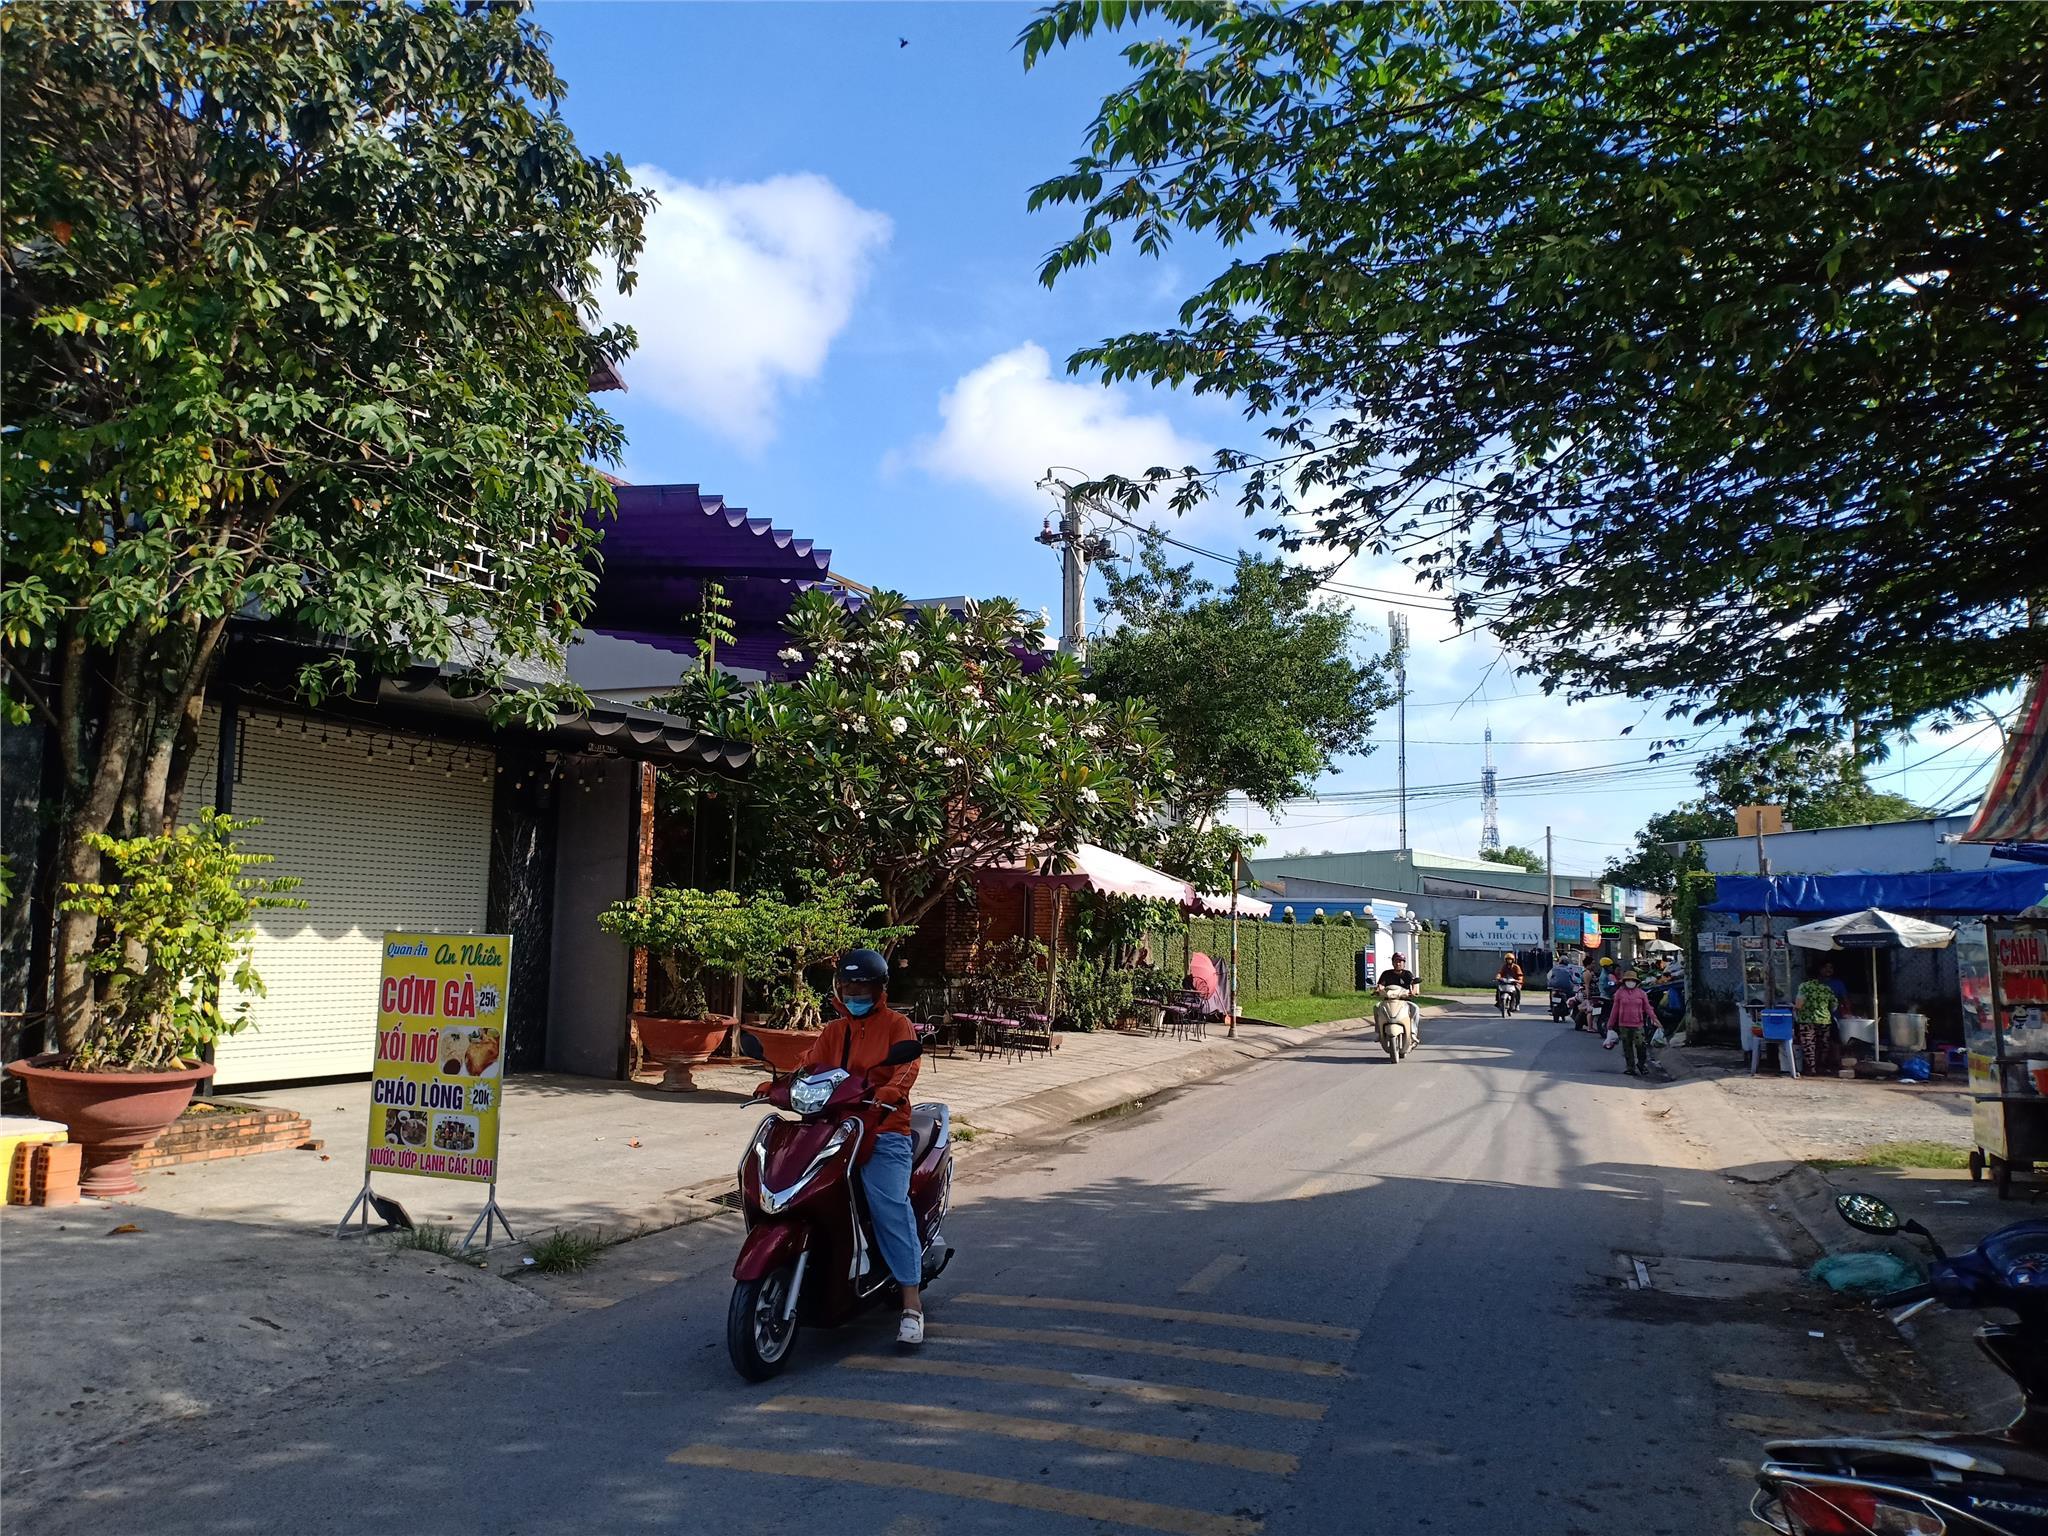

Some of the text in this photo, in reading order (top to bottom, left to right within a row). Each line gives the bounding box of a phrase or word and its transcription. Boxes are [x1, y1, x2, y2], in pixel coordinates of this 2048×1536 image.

[1465, 929, 1540, 940] NHÀ THUỐC TÂY
[435, 943, 458, 966] An
[461, 943, 504, 967] Nhiên
[381, 972, 476, 1019] CƠM GÀ
[479, 991, 497, 1008] 25k
[377, 1021, 440, 1064] XỐI MỠ
[374, 1075, 464, 1111] CHÁO LÒNG
[472, 1089, 490, 1106] 20k
[369, 1146, 494, 1181] NƯỚC ƯỚP LẠNH CÁC LOẠI
